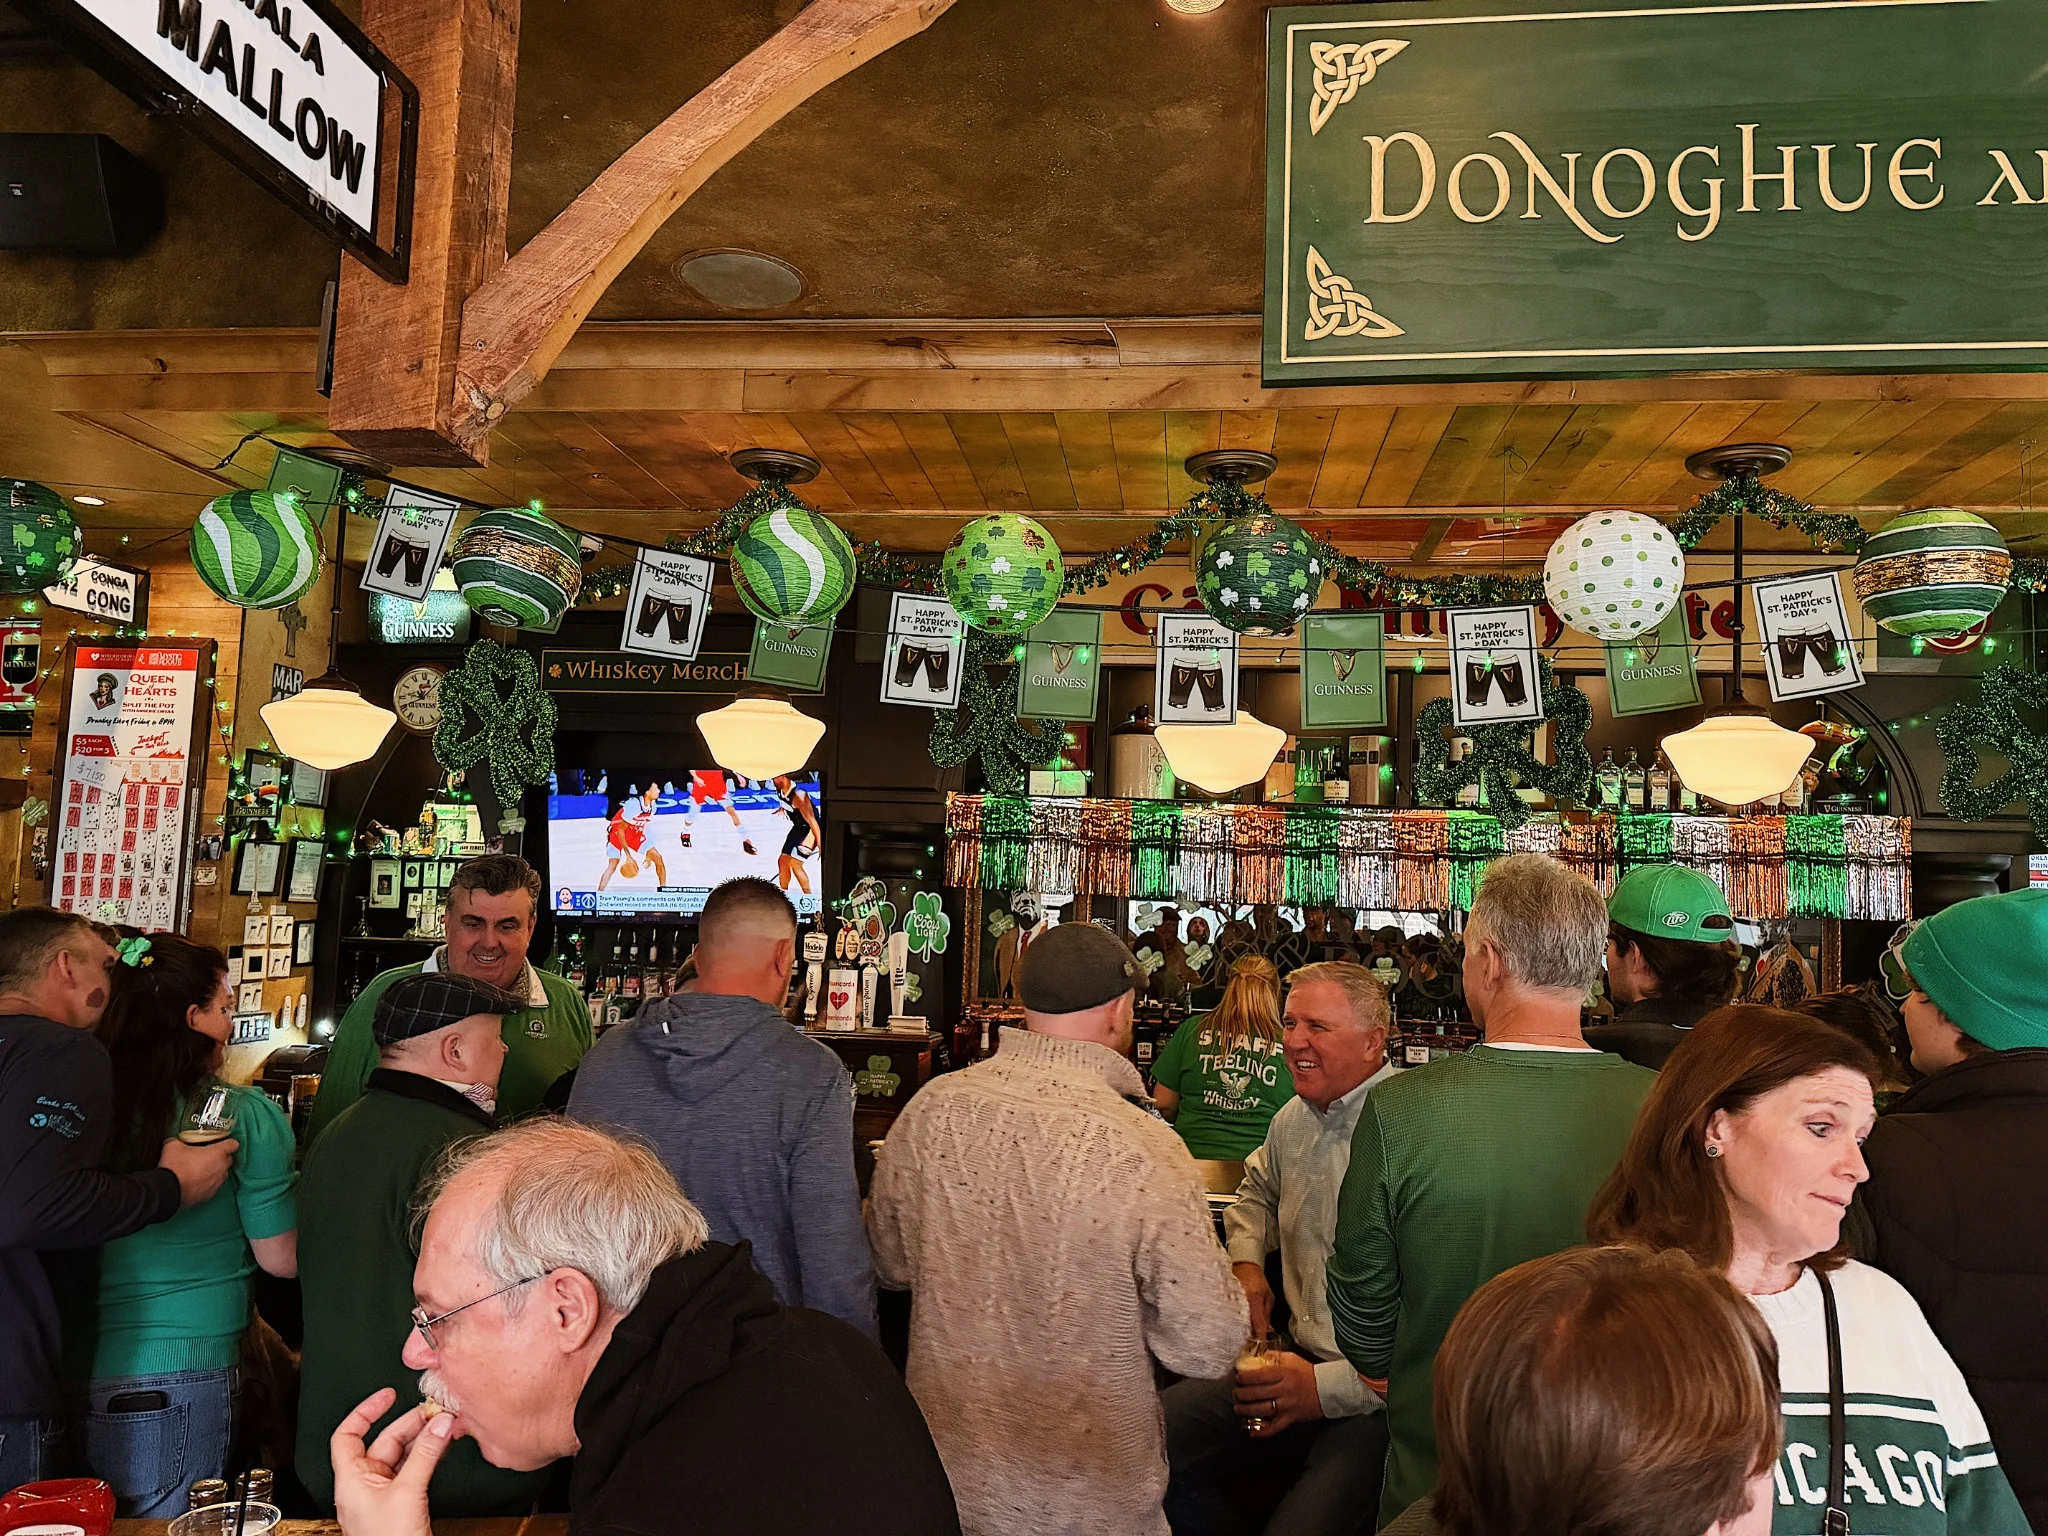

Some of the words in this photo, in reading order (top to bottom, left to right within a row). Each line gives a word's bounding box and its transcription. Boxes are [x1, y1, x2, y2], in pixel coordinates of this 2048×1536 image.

[240, 0, 324, 76] ALA
[156, 0, 366, 194] MALLOW
[406, 521, 423, 530] DAY
[661, 561, 690, 571] HAPPY
[91, 570, 129, 590] CONGA
[664, 577, 681, 587] DAY
[87, 588, 131, 613] CONG
[1780, 590, 1813, 602] HAPPY
[1767, 605, 1781, 613] ST.
[1783, 596, 1832, 611] PATRICK'S
[916, 609, 945, 618] HAPPY
[1791, 608, 1810, 618] DAY
[901, 616, 913, 624] ST.
[915, 618, 958, 627] PATRICK'S
[1473, 622, 1507, 631] HAPPY
[382, 620, 456, 638] GUINNESS
[919, 625, 937, 633] DAY
[1475, 629, 1524, 639] PATRICK'S
[1184, 636, 1229, 644] PATRICK'S
[1481, 639, 1500, 647] DAY
[764, 639, 818, 658] GUINNESS
[1621, 664, 1682, 681] GUINNESS
[129, 673, 175, 686] QUEEN
[273, 665, 303, 693] MAR
[1031, 674, 1087, 689] GUINNESS
[124, 686, 178, 697] HEARTS
[1314, 683, 1373, 696] GUINNESS
[76, 738, 87, 746] $5
[236, 806, 271, 816] GUINNESS
[1830, 805, 1862, 813] GUINNESS
[914, 914, 940, 930] Coors
[916, 930, 939, 939] LIGHT
[1199, 1053, 1277, 1087] TEELING
[1203, 1089, 1261, 1111] WHISKEY
